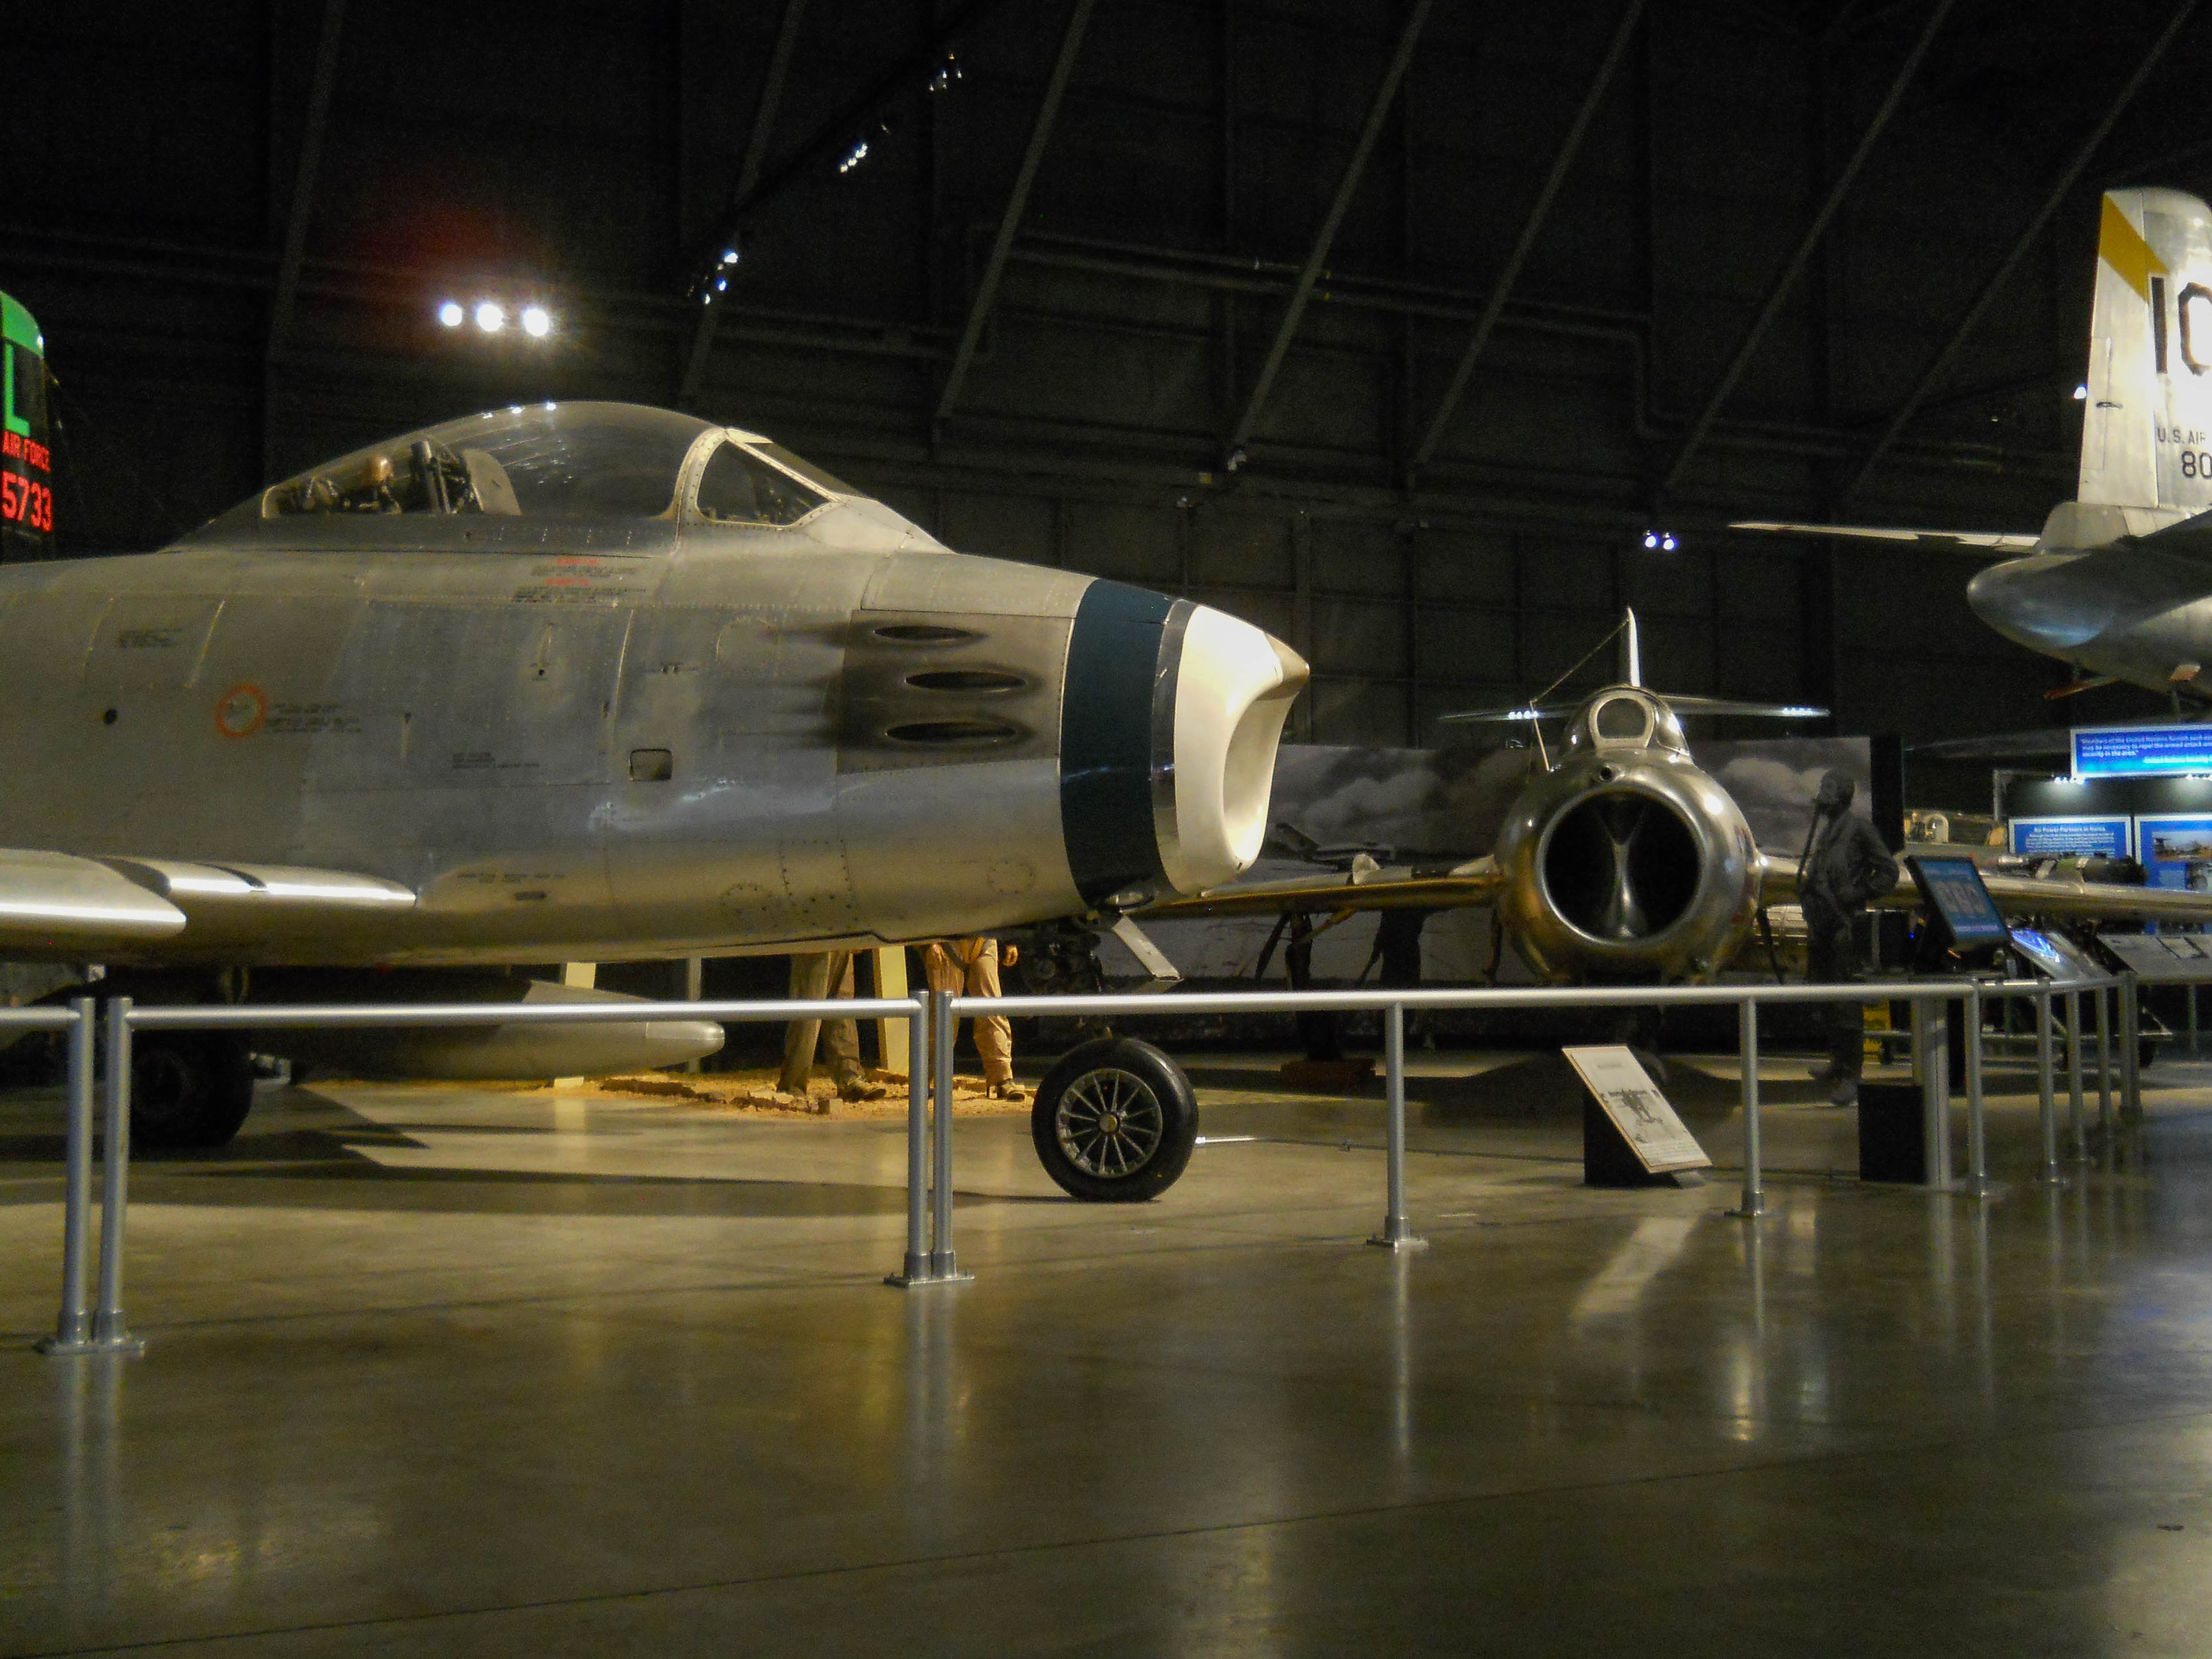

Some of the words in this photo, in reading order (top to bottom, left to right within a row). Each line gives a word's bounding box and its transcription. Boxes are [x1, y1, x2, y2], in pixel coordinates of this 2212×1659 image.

[3, 431, 21, 458] AIR
[23, 438, 50, 472] FORCE
[2158, 427, 2185, 443] U.S.
[2, 470, 52, 531] 5733
